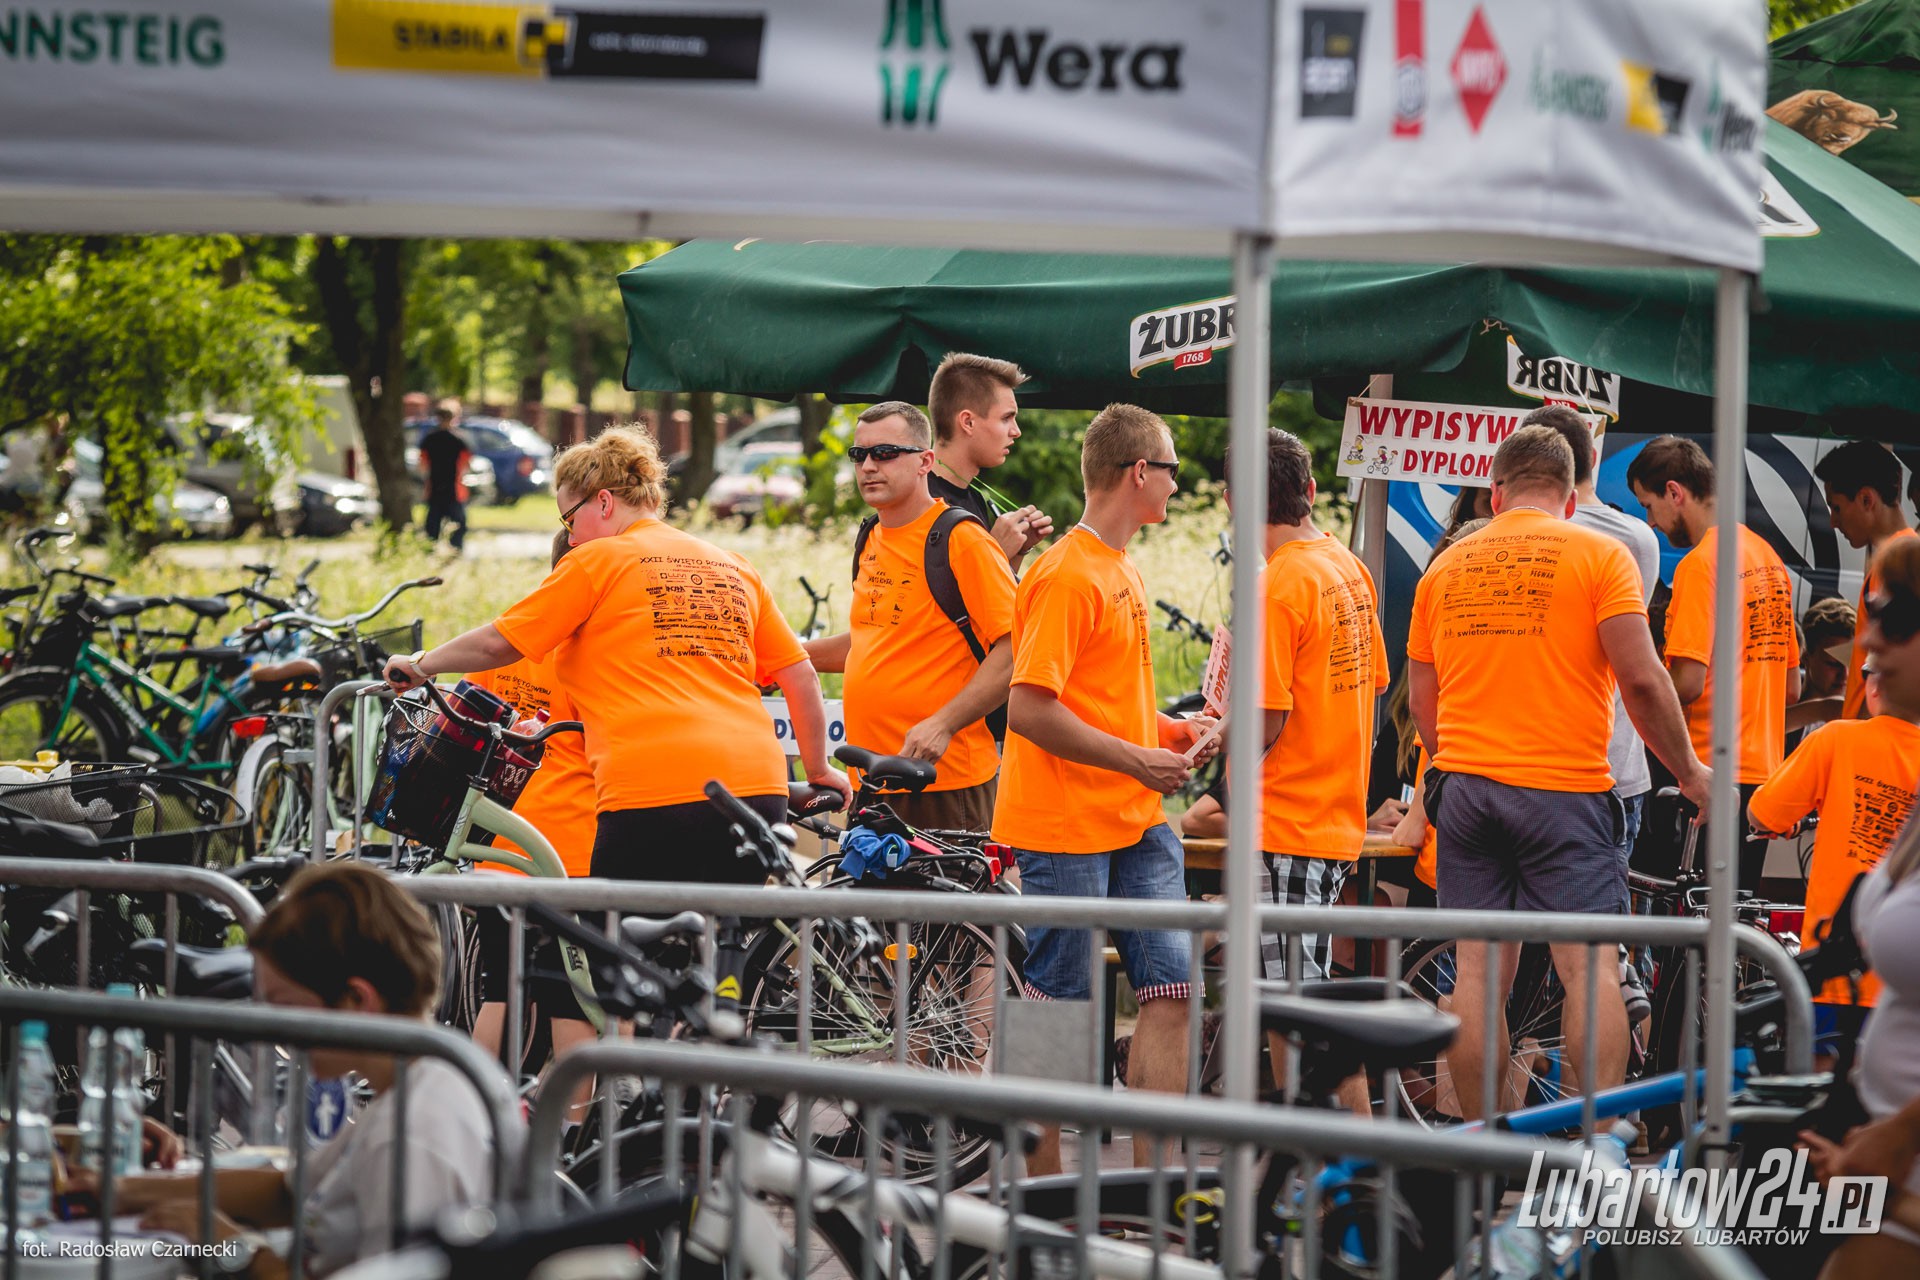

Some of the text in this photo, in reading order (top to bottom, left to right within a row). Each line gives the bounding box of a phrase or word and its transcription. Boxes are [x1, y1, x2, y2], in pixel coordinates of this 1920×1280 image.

[969, 28, 1185, 91] Wera
[1182, 352, 1204, 364] 1768
[1360, 405, 1518, 445] WYPISYW
[639, 556, 664, 564] XXII
[1457, 628, 1526, 638] swietoroweru.pl
